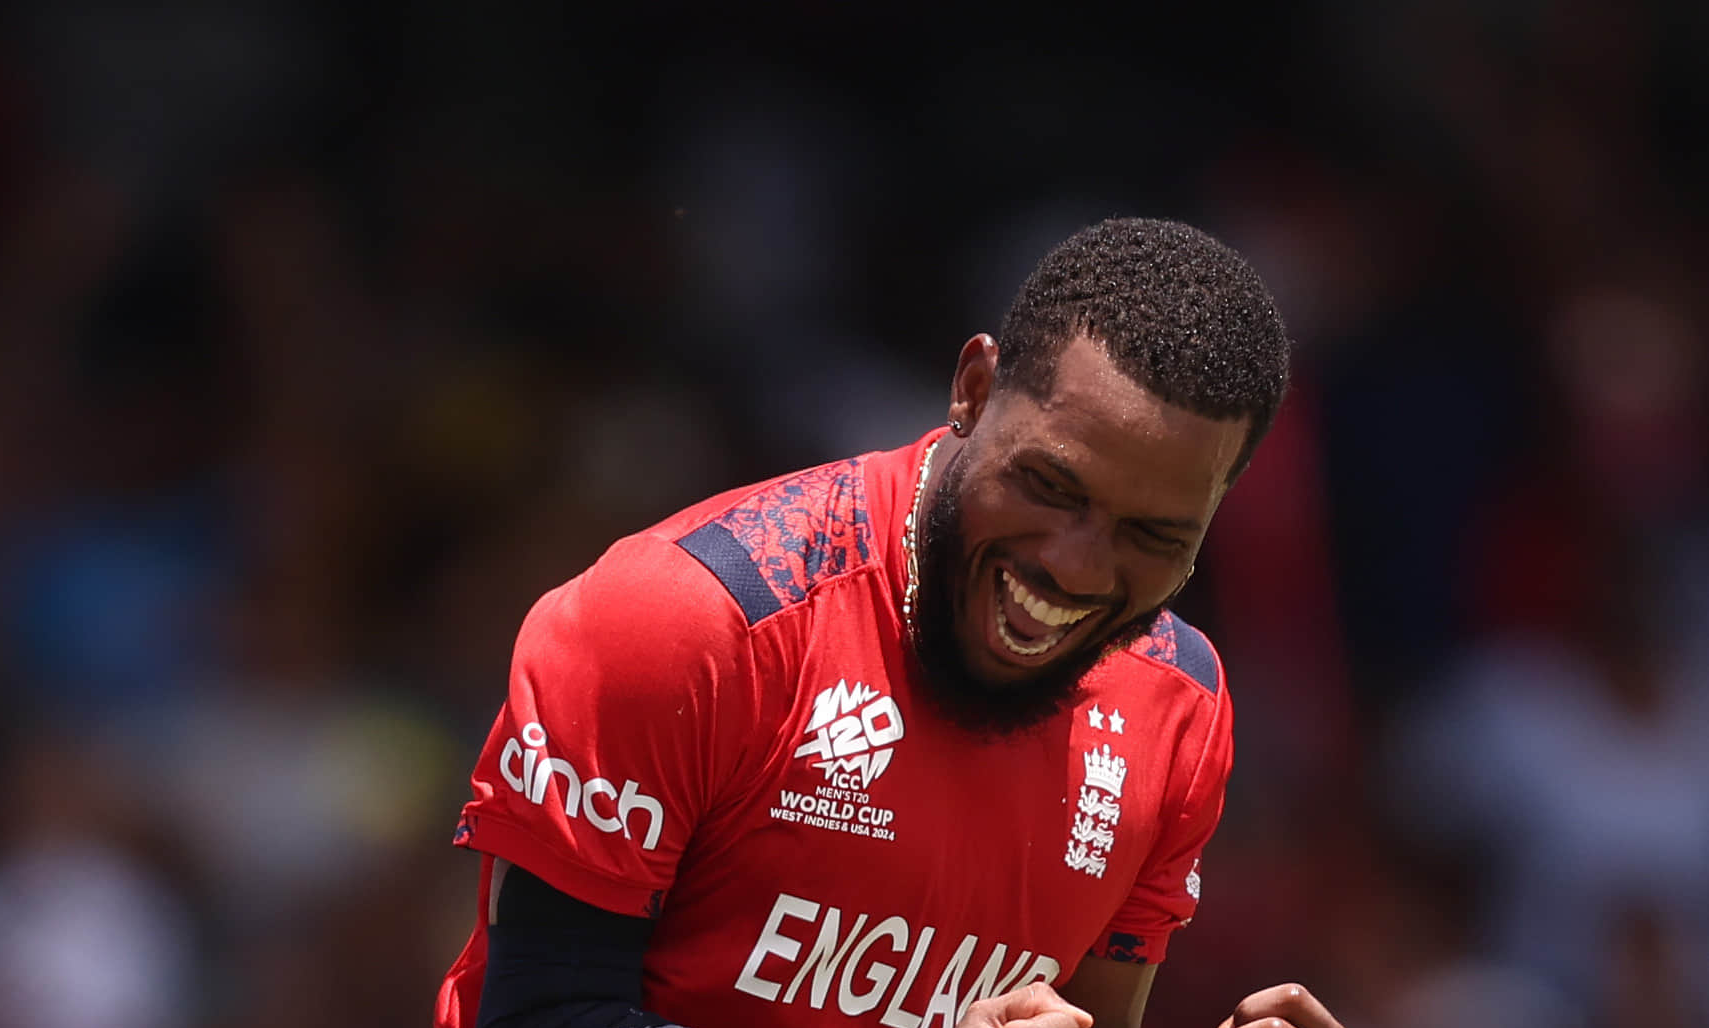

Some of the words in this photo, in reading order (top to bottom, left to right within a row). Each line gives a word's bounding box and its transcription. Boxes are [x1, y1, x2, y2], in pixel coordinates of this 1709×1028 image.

[794, 695, 904, 760] T20
[500, 722, 664, 850] cinch
[815, 785, 852, 801] MEN'S
[852, 791, 870, 804] T20
[832, 772, 861, 790] ICC
[770, 807, 803, 822] WEST
[803, 814, 841, 830] INDIES
[841, 821, 848, 832] &
[850, 823, 870, 836] USA
[872, 828, 895, 841] 2024
[780, 789, 855, 820] WORLD
[857, 806, 894, 827] CUP
